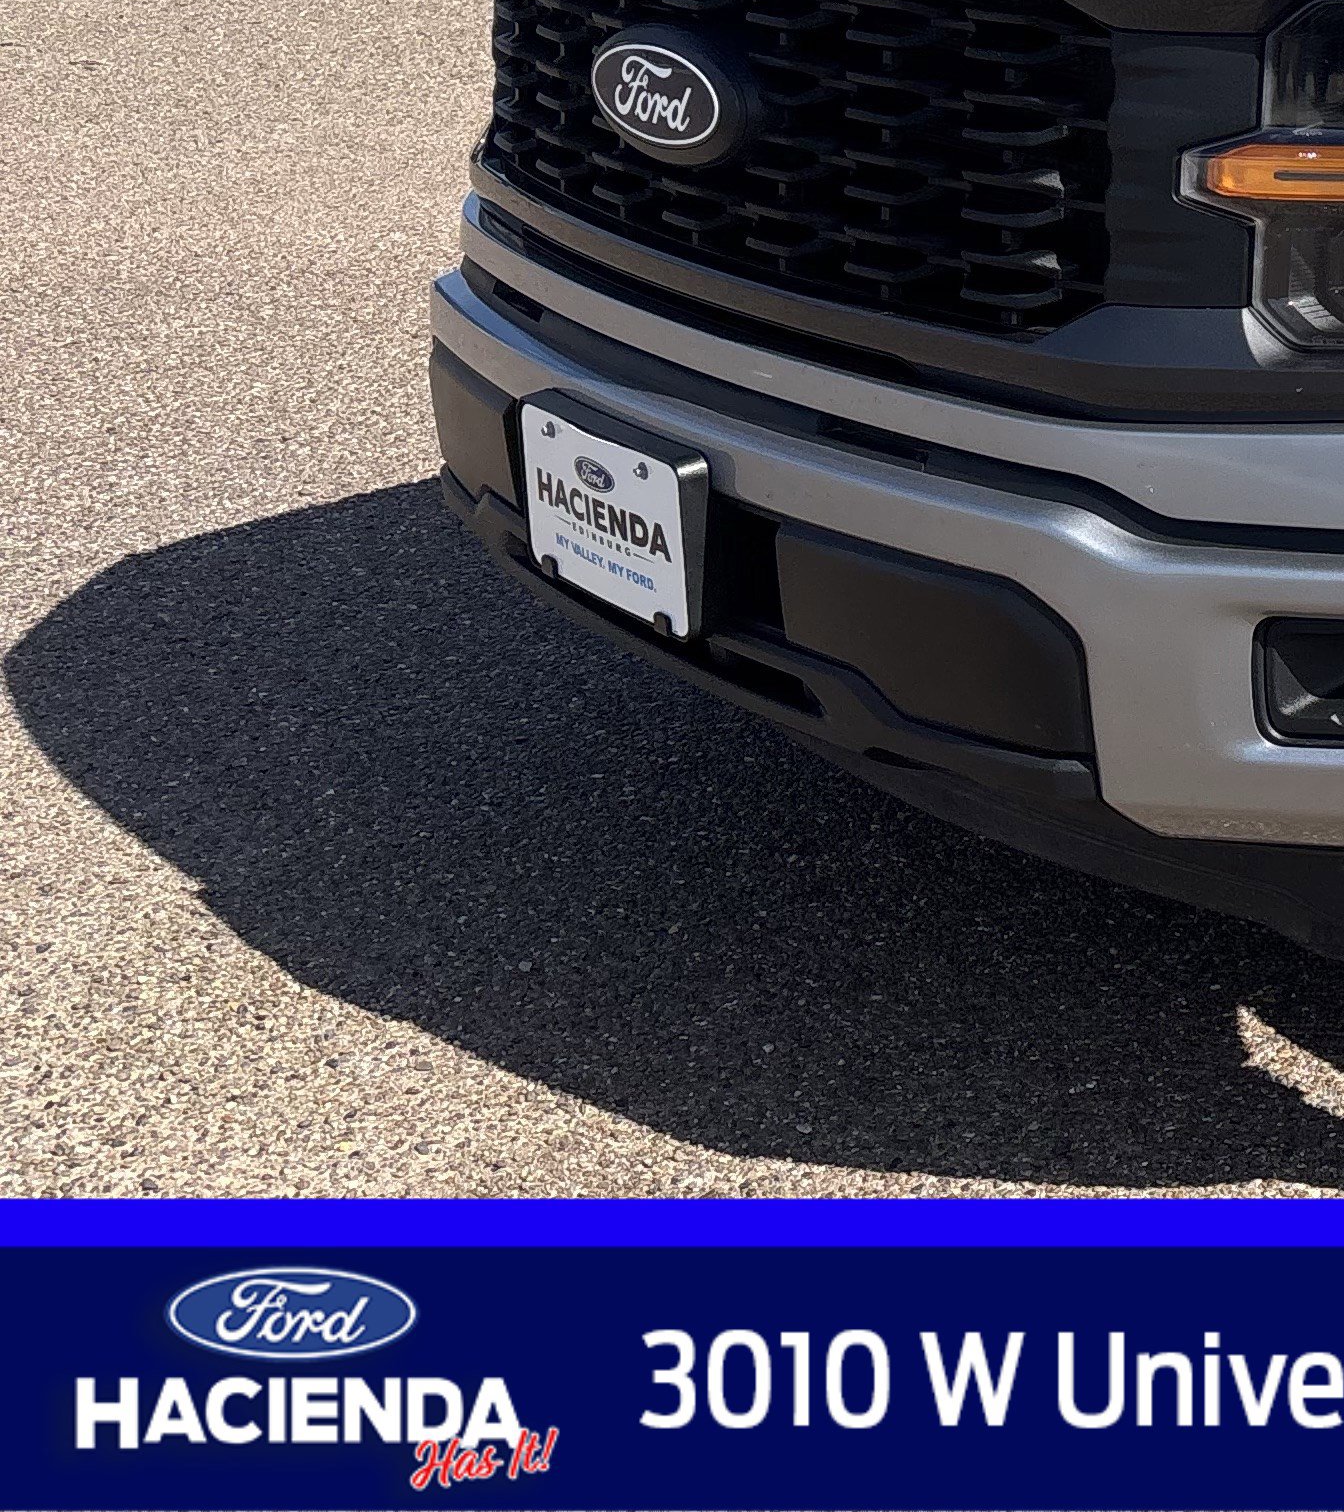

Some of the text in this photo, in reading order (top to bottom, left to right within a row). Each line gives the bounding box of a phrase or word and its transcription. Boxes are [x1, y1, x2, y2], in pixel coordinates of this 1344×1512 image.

[614, 55, 692, 132] Ford
[580, 462, 606, 488] Ford
[536, 466, 672, 564] HACIENDA
[572, 521, 631, 557] EDINBURG
[556, 532, 657, 594] MY VALLEY. MY FORD.
